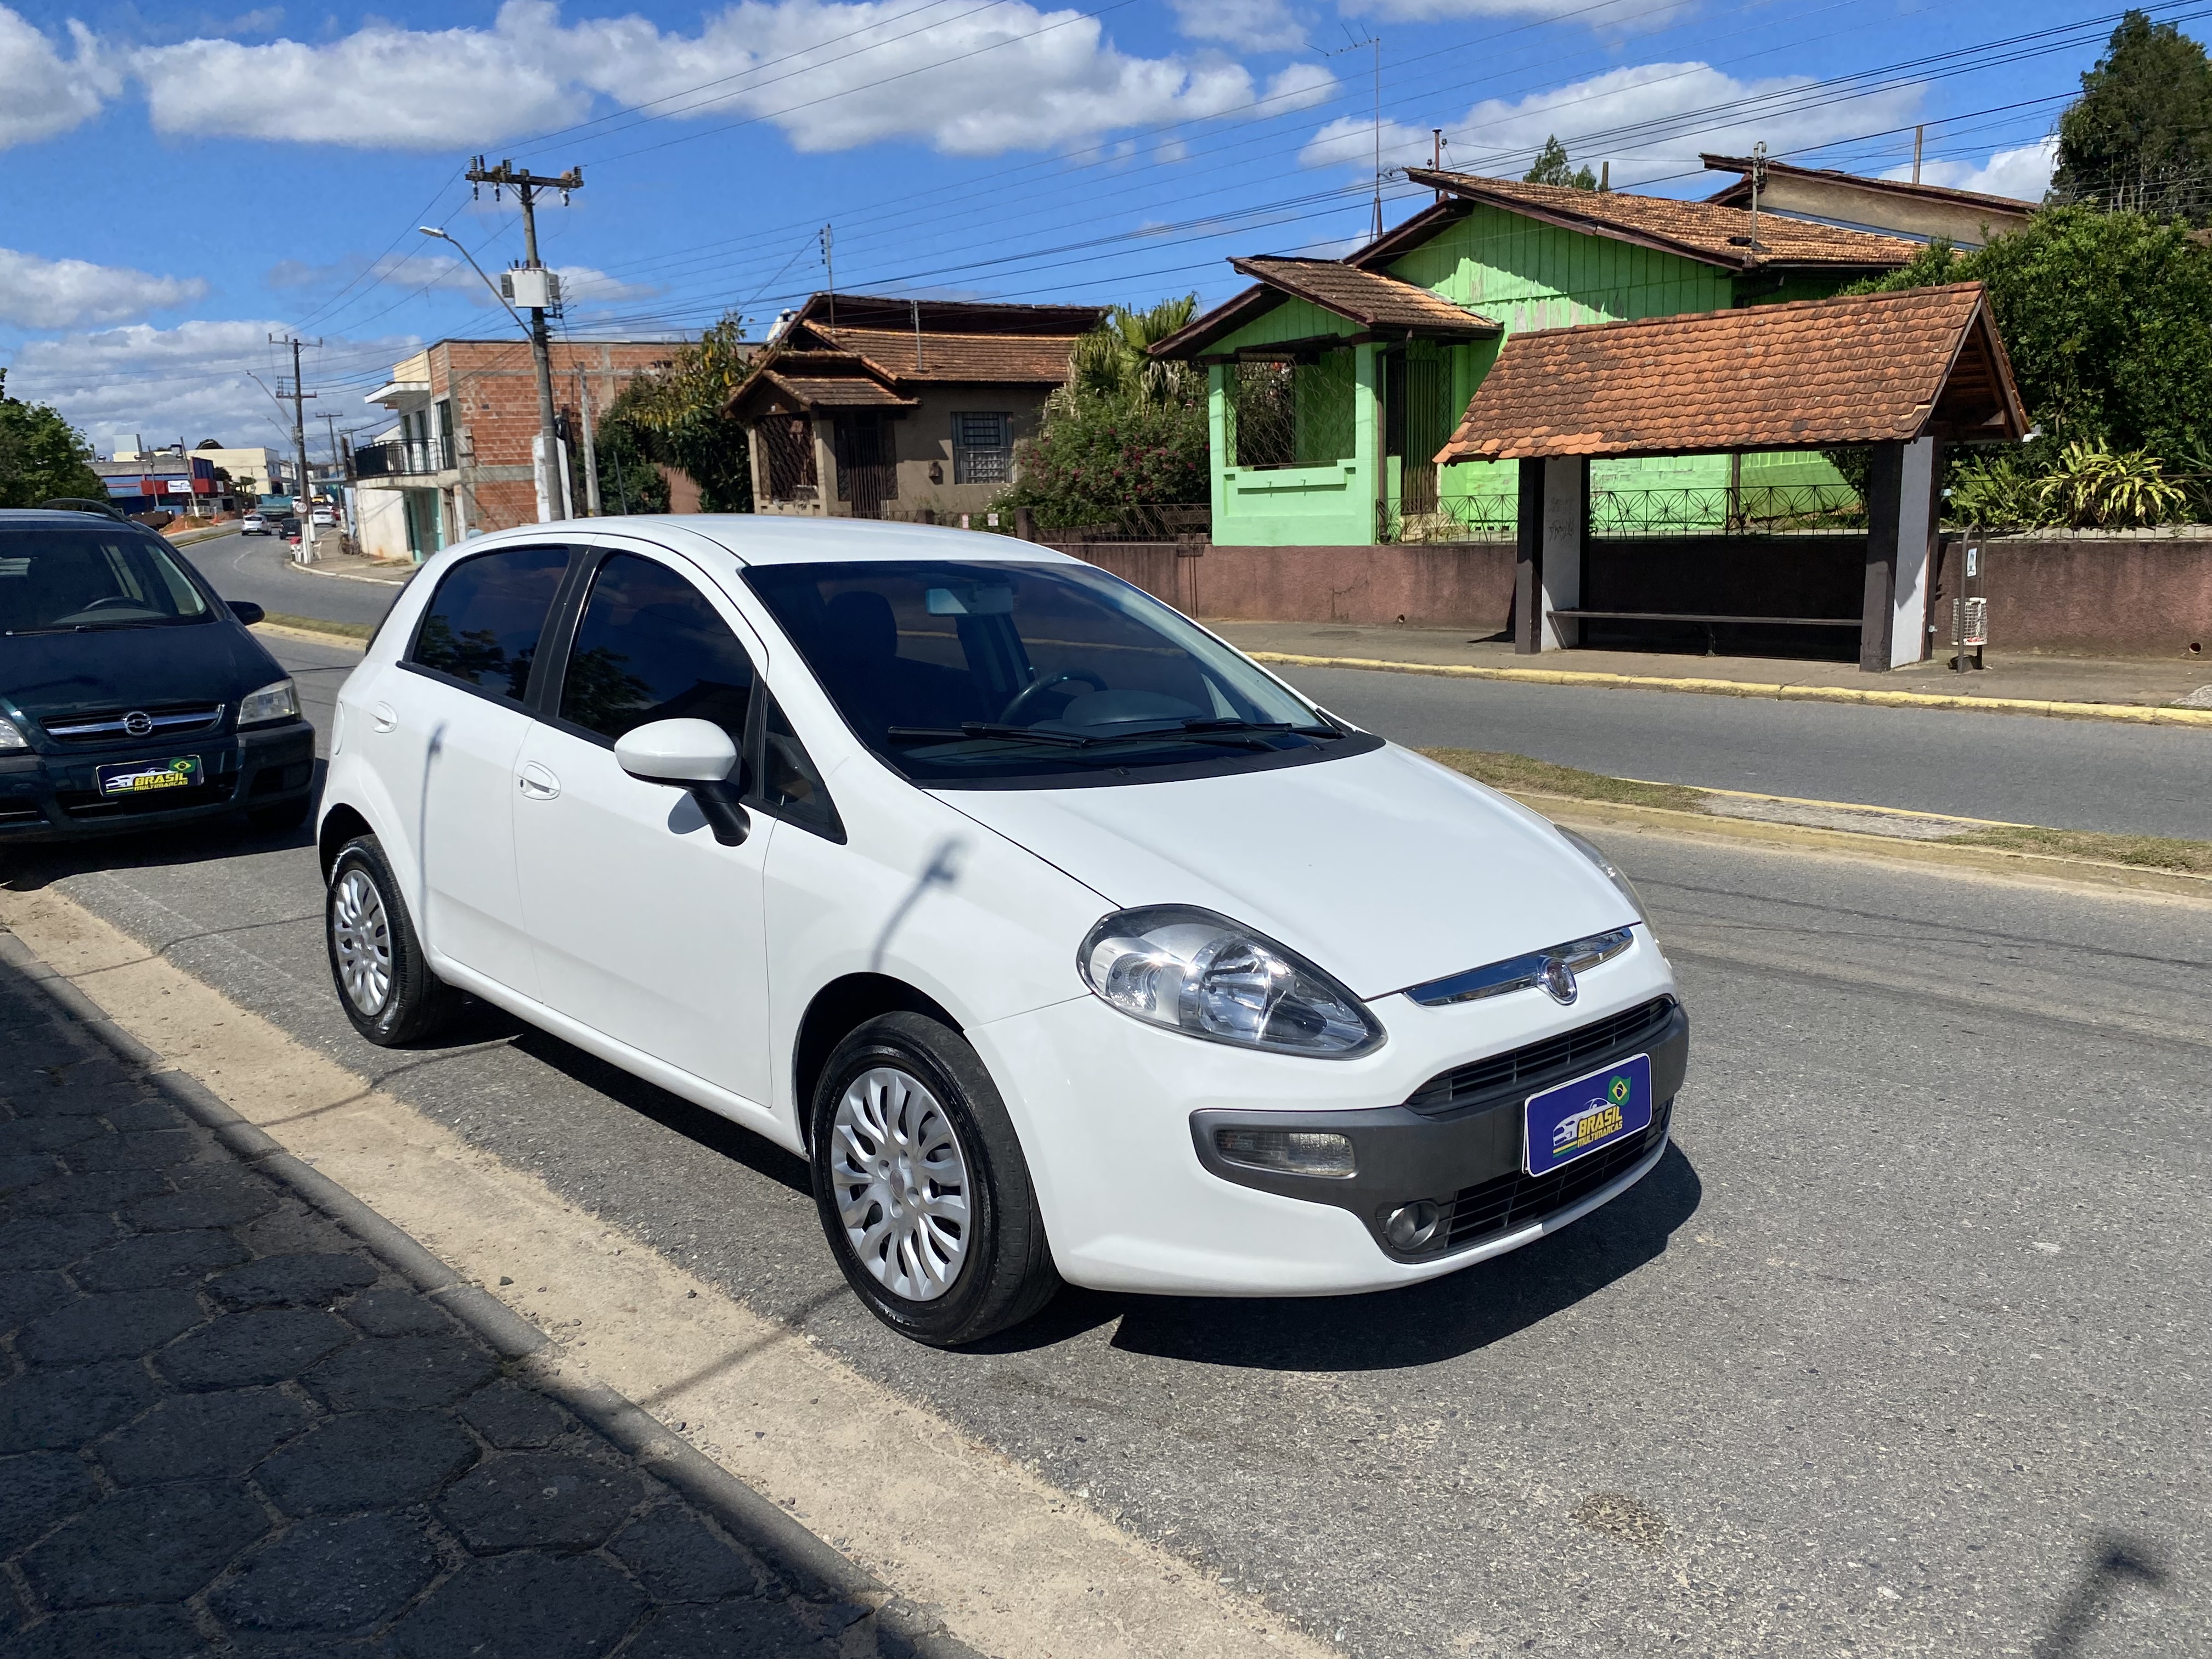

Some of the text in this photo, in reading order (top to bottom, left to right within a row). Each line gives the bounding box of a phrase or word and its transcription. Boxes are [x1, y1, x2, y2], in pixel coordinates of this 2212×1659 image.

[134, 780, 188, 791] MULTIMARCAS
[135, 772, 188, 786] BRASIL
[1578, 1106, 1622, 1138] BRASIL
[1577, 1120, 1623, 1148] MULTIMARCAS
